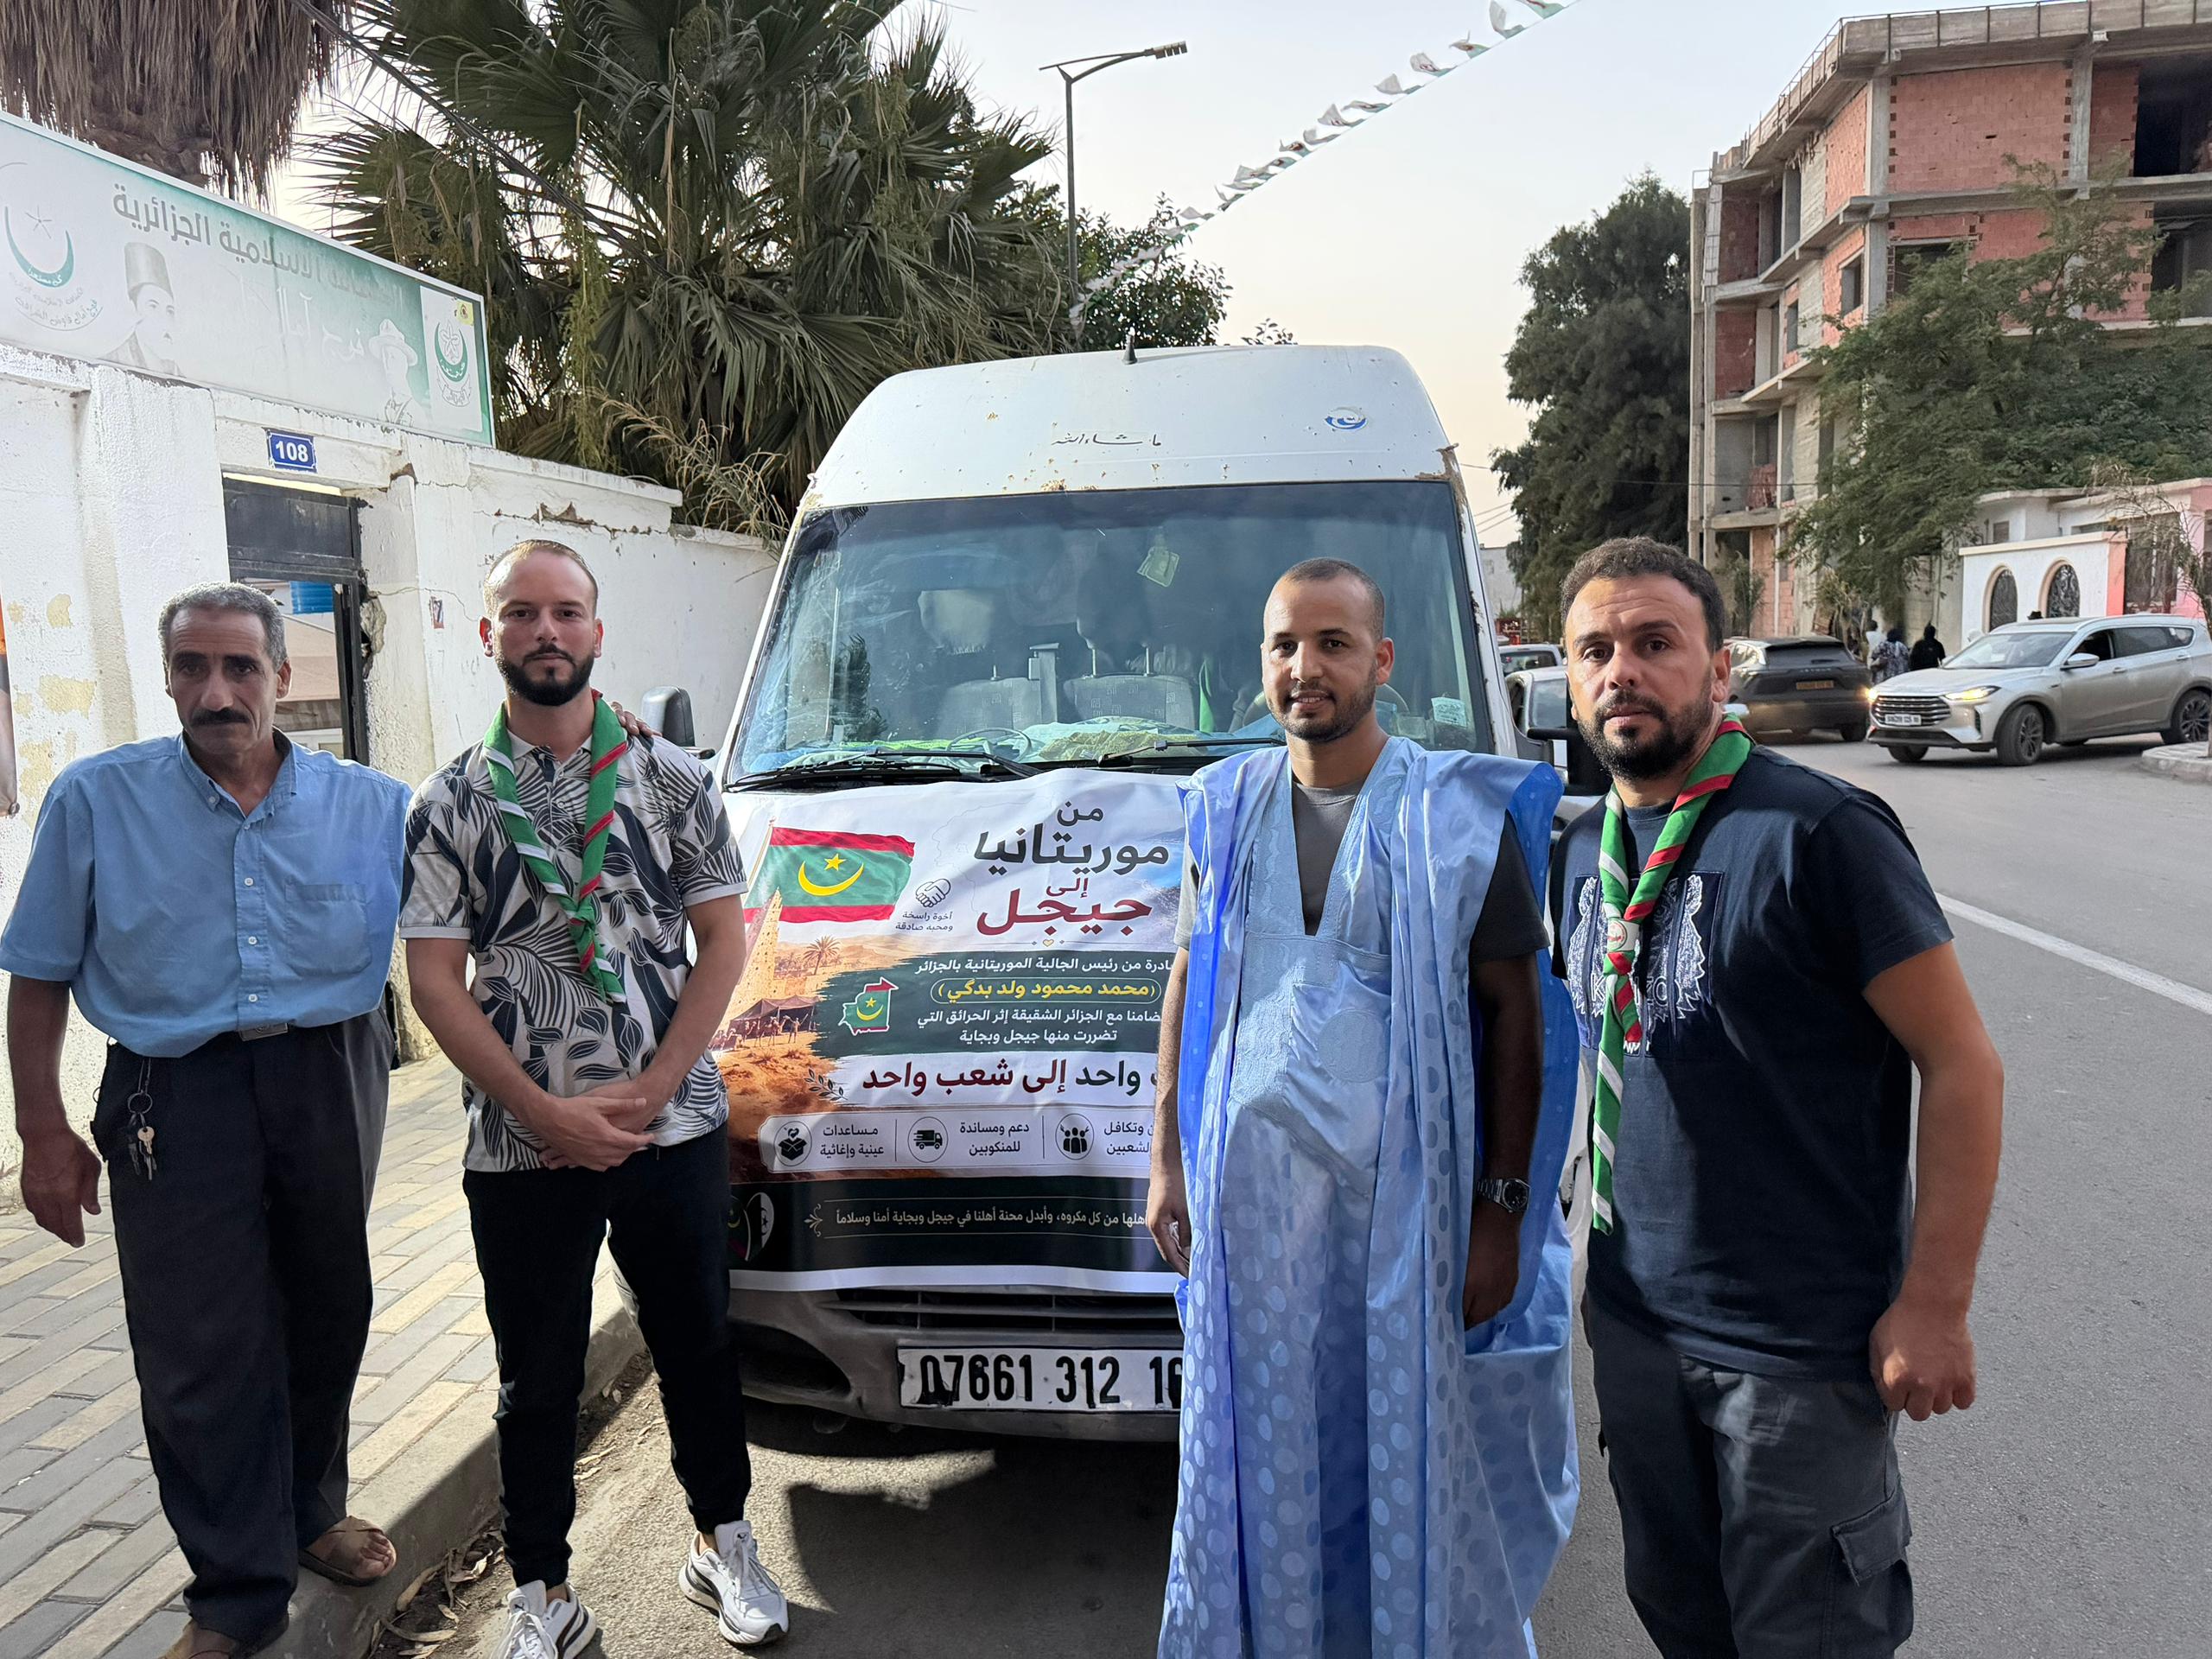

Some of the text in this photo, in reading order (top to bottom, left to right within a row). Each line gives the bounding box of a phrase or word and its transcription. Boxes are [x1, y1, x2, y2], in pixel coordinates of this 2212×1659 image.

[113, 183, 211, 246] الجزائرية
[276, 441, 308, 462] 108
[1057, 801, 1103, 827] من
[974, 823, 1169, 876] موريتانيا
[1046, 877, 1089, 899] إلى
[902, 911, 953, 921] أخوة راسخة
[976, 888, 1153, 937] جيجل
[895, 922, 924, 931] صادقة
[914, 959, 962, 975] بالجزائر
[964, 957, 1033, 972] الموريتانية
[1036, 957, 1078, 972] الجالية
[1082, 957, 1118, 972] رئيس
[1122, 960, 1141, 973] من
[996, 980, 1027, 999] ولد
[1031, 982, 1093, 999] محمود
[917, 1008, 1161, 1028] ضامنا مع الجزائر الشقيقة إثر الحرائق التي
[959, 1029, 1117, 1046] تضررت منها جيجل وبجاية
[862, 1061, 926, 1096] واحد
[936, 1058, 1014, 1095] شعب
[1023, 1058, 1067, 1094] إلى
[1076, 1060, 1141, 1096] واحد
[823, 1123, 879, 1136] مساعدات
[960, 1122, 1029, 1137] دعم ومساندة
[1104, 1122, 1144, 1135] وتكافل
[820, 1143, 884, 1159] عينية وإغاثية
[969, 1141, 1020, 1156] للمنكوبين
[1107, 1141, 1149, 1155] لشعبين
[892, 1211, 925, 1225] وبجاية
[927, 1211, 955, 1224] جيجل
[957, 1210, 971, 1227] في
[974, 1206, 996, 1221] أهلنا
[999, 1210, 1023, 1222] محنة
[1026, 1206, 1053, 1224] وأبدل
[1089, 1211, 1102, 1226] كل
[1103, 1214, 1119, 1227] من
[918, 1354, 1033, 1406] 07661
[1056, 1356, 1120, 1408] 312
